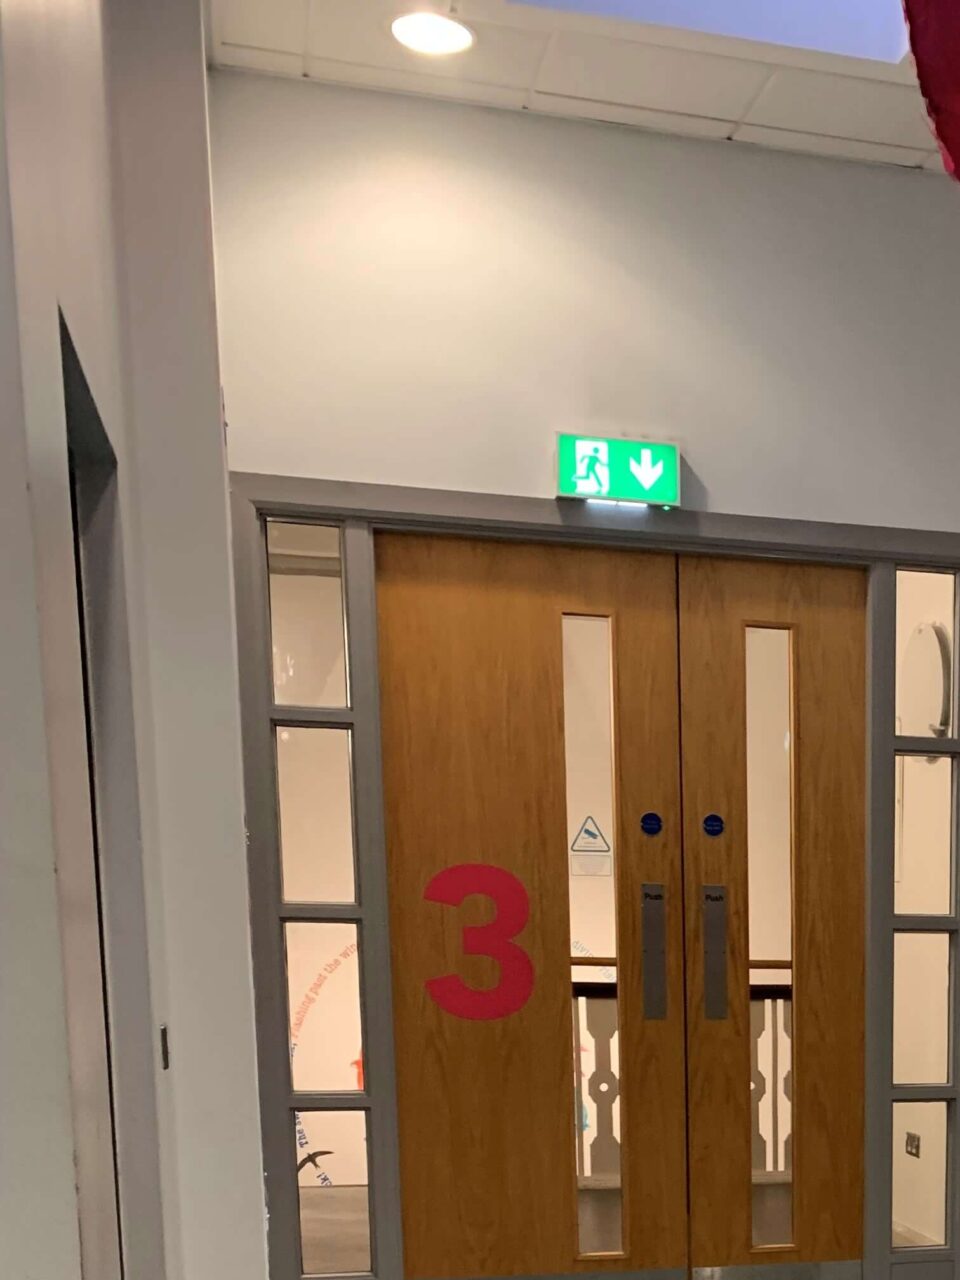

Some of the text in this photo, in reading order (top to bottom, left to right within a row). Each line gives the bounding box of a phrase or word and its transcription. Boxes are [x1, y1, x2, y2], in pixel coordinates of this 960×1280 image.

[705, 894, 724, 902] Push
[423, 863, 535, 1021] 3
[308, 973, 328, 996] past
[323, 958, 342, 974] the
